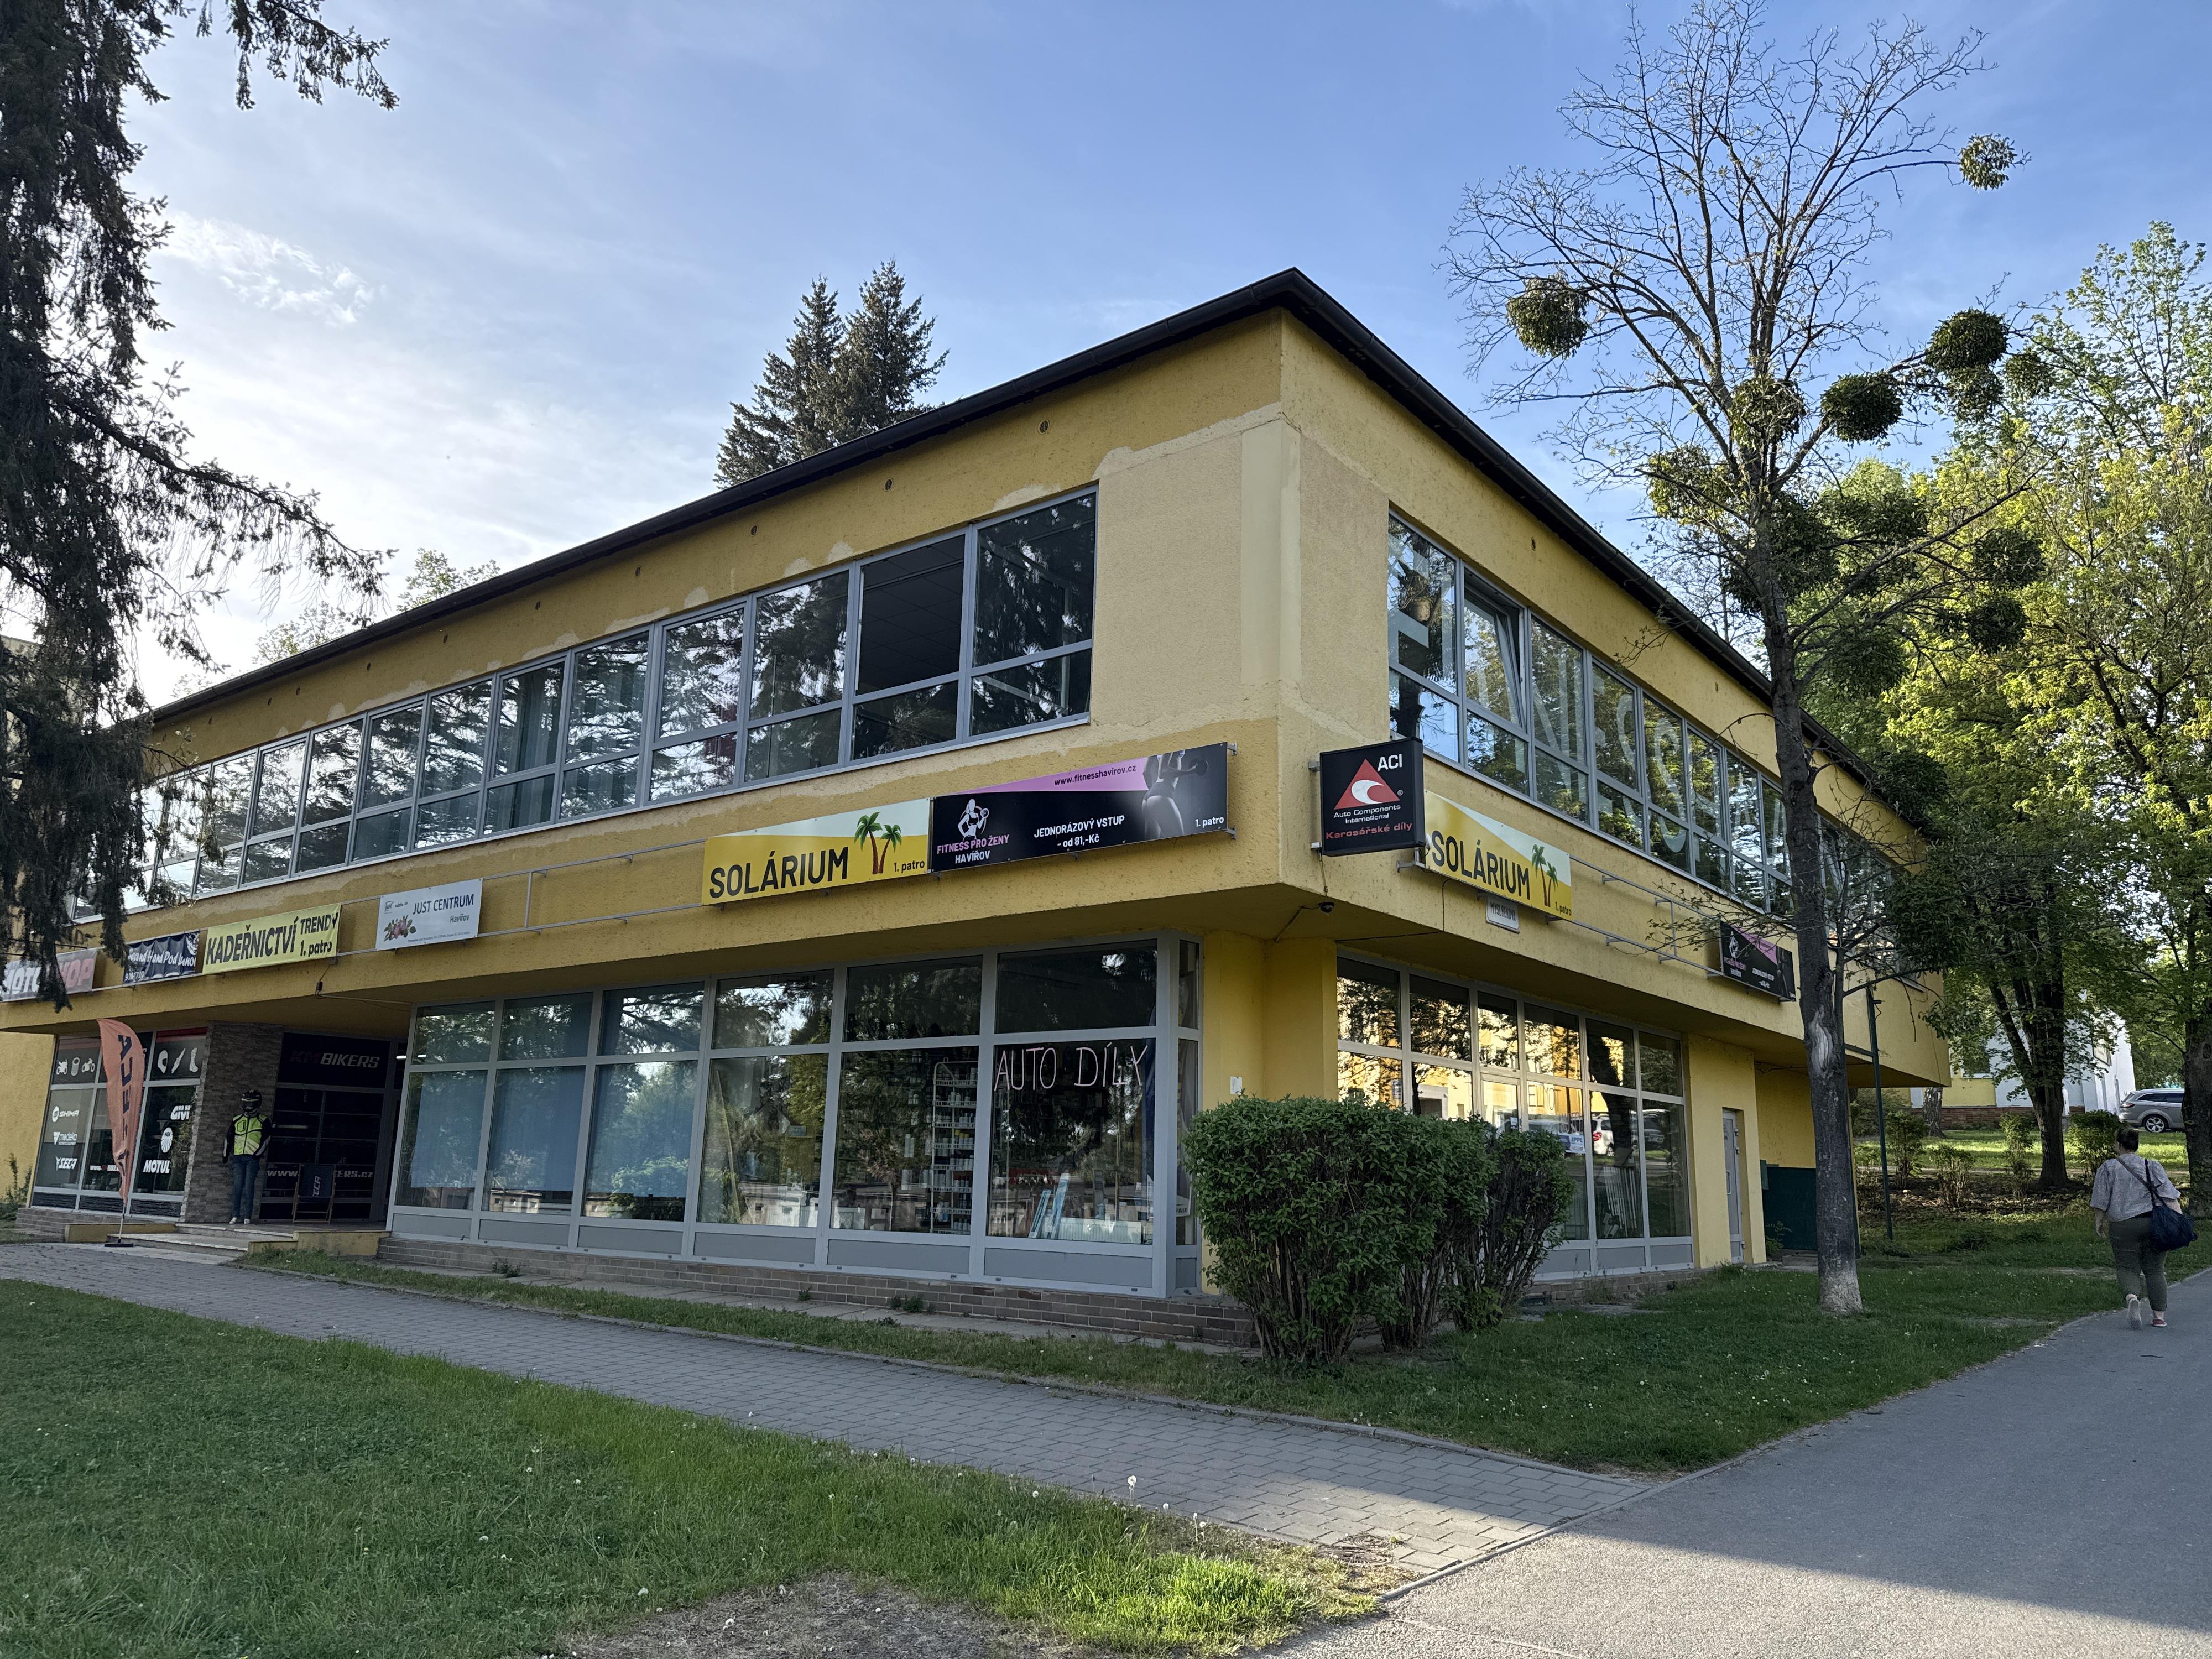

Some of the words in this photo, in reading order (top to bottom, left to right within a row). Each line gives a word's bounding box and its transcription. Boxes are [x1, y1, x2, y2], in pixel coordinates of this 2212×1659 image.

[1377, 753, 1402, 771] ACI
[1054, 765, 1136, 786] www.fitnesshavirov.cz
[1353, 804, 1401, 816] Components
[1034, 817, 1094, 838] JEDNORÁZOVÝ
[1096, 815, 1125, 830] VSTUP
[1195, 818, 1201, 827] 1.
[1202, 816, 1224, 828] patro
[1345, 813, 1389, 824] International
[1326, 823, 1390, 839] Karosářské
[1394, 822, 1413, 831] díly
[936, 841, 969, 854] FITNESS
[971, 838, 987, 849] PRO
[988, 834, 1010, 847] ŽENY
[1063, 838, 1073, 848] od
[1074, 834, 1100, 847] 81,-Kč
[955, 849, 991, 864] HAVÍŘOV
[709, 846, 849, 899] SOLÁRIUM
[894, 862, 899, 872] 1.
[901, 860, 925, 874] patro
[1431, 830, 1531, 900] SOLÁRIUM
[413, 900, 432, 915] JUST
[433, 894, 474, 911] CENTRUM
[1555, 901, 1559, 912] 1.
[1559, 905, 1572, 916] patro
[300, 912, 339, 935] TRENDY
[450, 912, 470, 924] Havířov
[205, 915, 299, 965] KADEŘNICTVÍ
[300, 940, 306, 956] 1.
[308, 938, 332, 957] patro
[994, 1047, 1057, 1092] AUTO
[1074, 1041, 1149, 1088] DÍLY
[59, 1109, 80, 1118] SHIMA
[170, 1105, 191, 1120] GIVI
[59, 1157, 78, 1170] SECA
[143, 1159, 170, 1174] MOTUL
